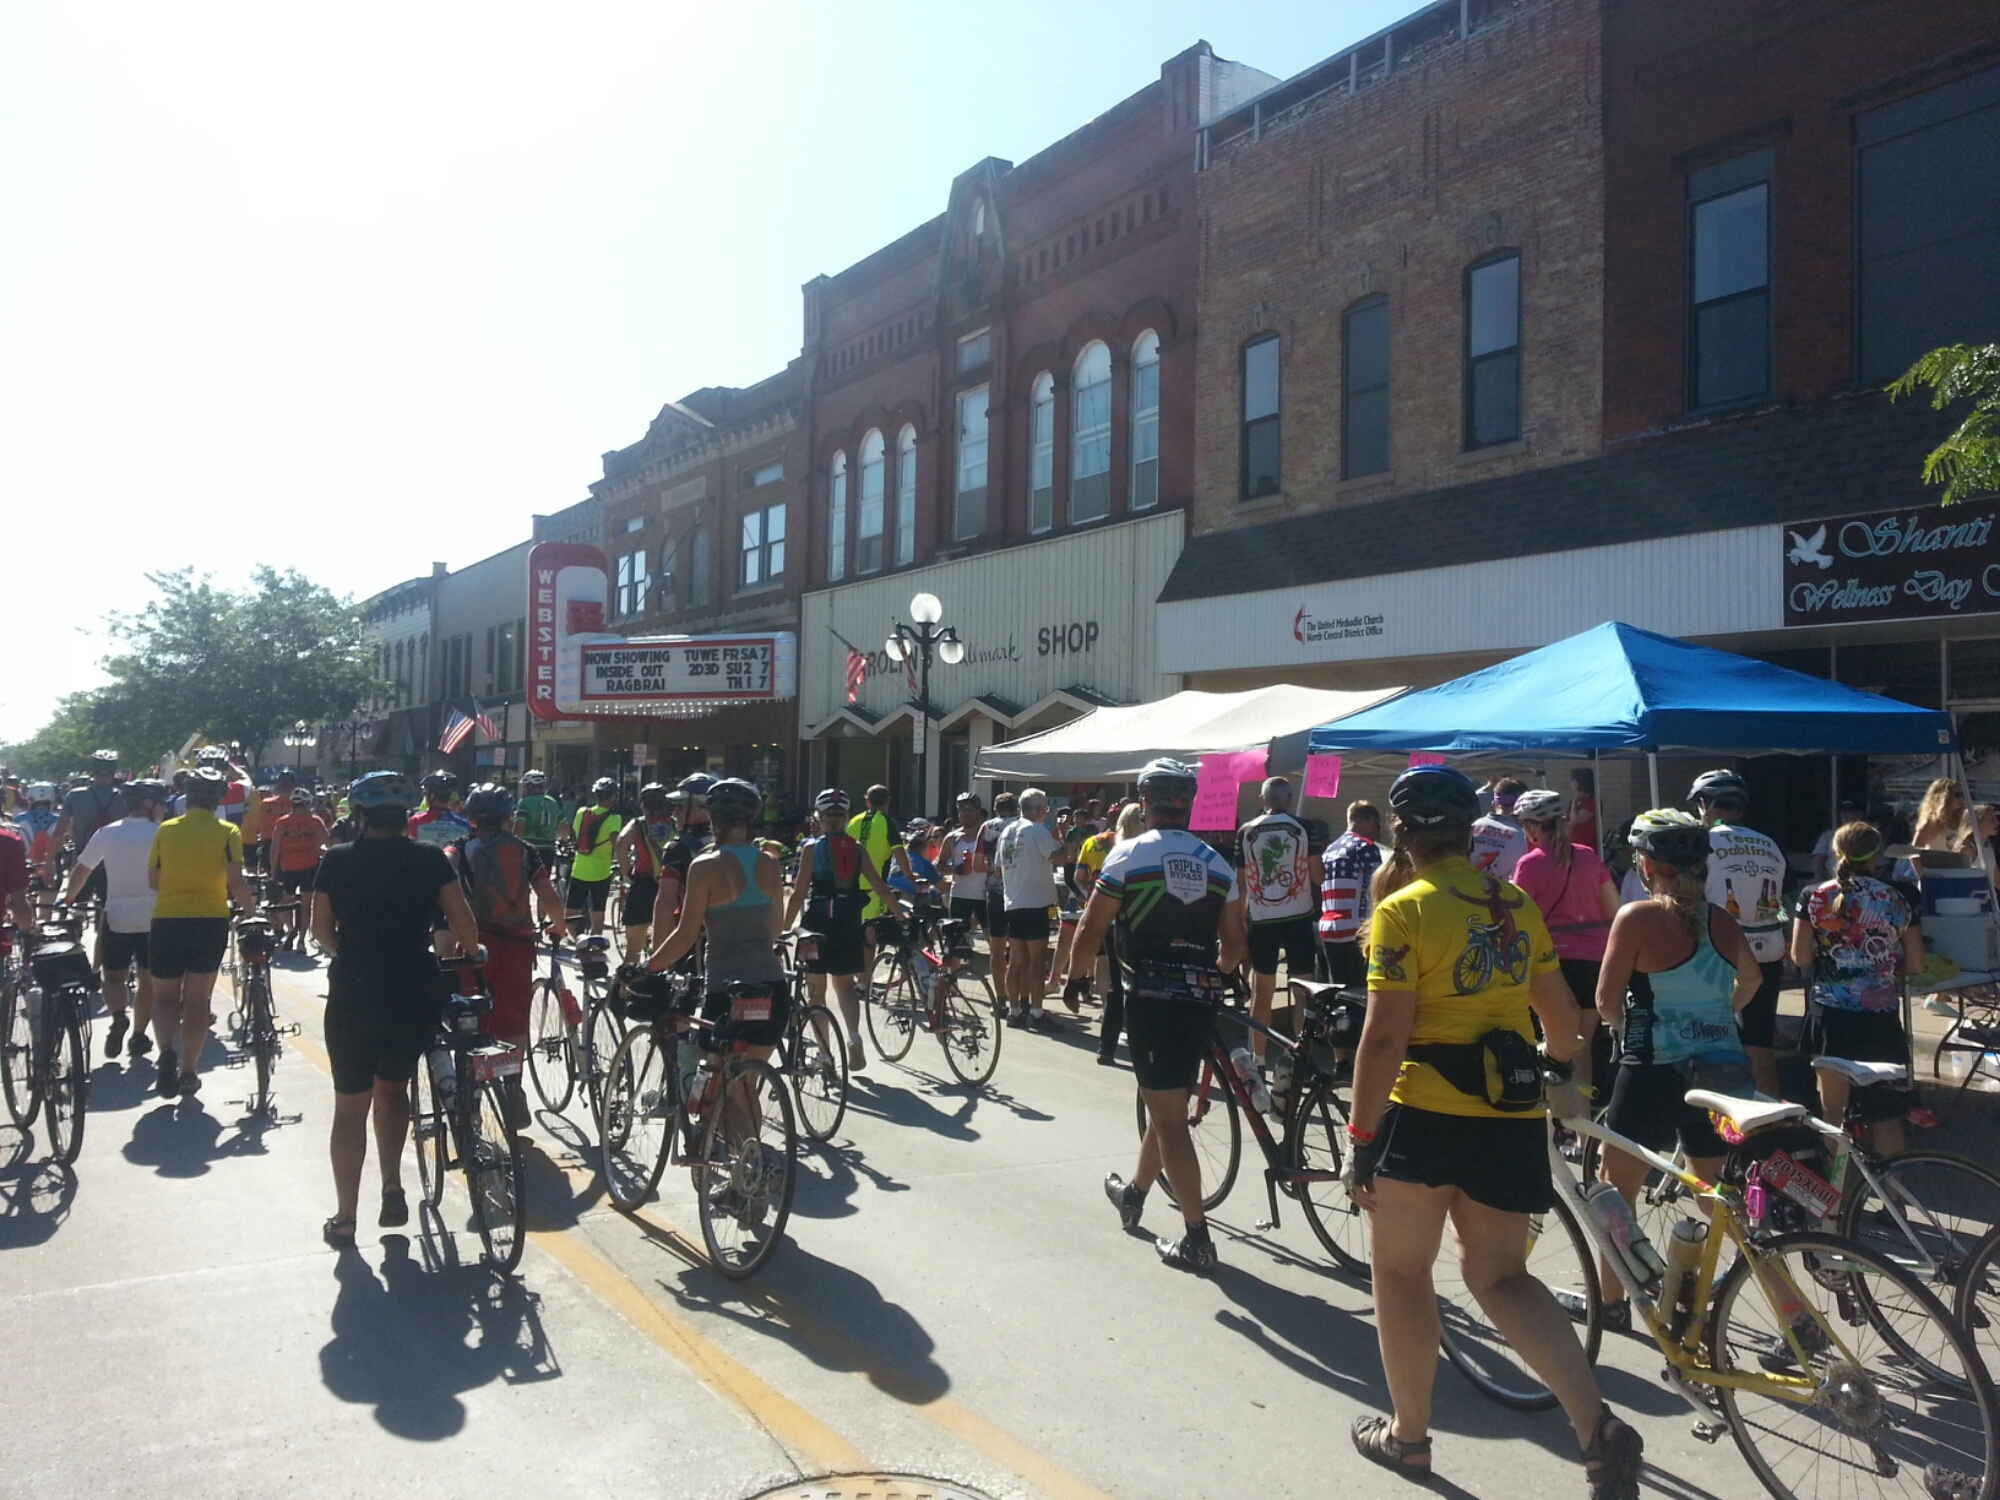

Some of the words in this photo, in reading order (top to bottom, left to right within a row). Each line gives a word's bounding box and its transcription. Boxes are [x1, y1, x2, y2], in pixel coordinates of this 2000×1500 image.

[1838, 513, 1995, 558] Shanti
[1790, 577, 1897, 612] Wellness
[1903, 570, 1972, 610] Day
[1307, 621, 1316, 631] The
[1317, 619, 1335, 630] United
[1336, 616, 1363, 629] Methodist
[1364, 614, 1384, 626] Church
[537, 569, 554, 700] WEBSTER
[1038, 621, 1099, 656] SHOP
[1307, 632, 1322, 642] North
[1324, 630, 1343, 640] Central
[1344, 627, 1364, 638] District
[1365, 625, 1383, 636] Office
[585, 652, 612, 665] NOW
[613, 650, 670, 664] SHOWING
[760, 646, 769, 660] 7
[596, 664, 634, 678] INSIDE
[641, 664, 663, 677] OUT
[761, 661, 770, 674] 7
[606, 678, 665, 692] RAGBRAI
[727, 676, 742, 689] TH
[759, 675, 768, 689] 7
[1720, 833, 1772, 848] Team
[1167, 859, 1203, 874] TRIPLE
[1170, 870, 1203, 882] BYPASS
